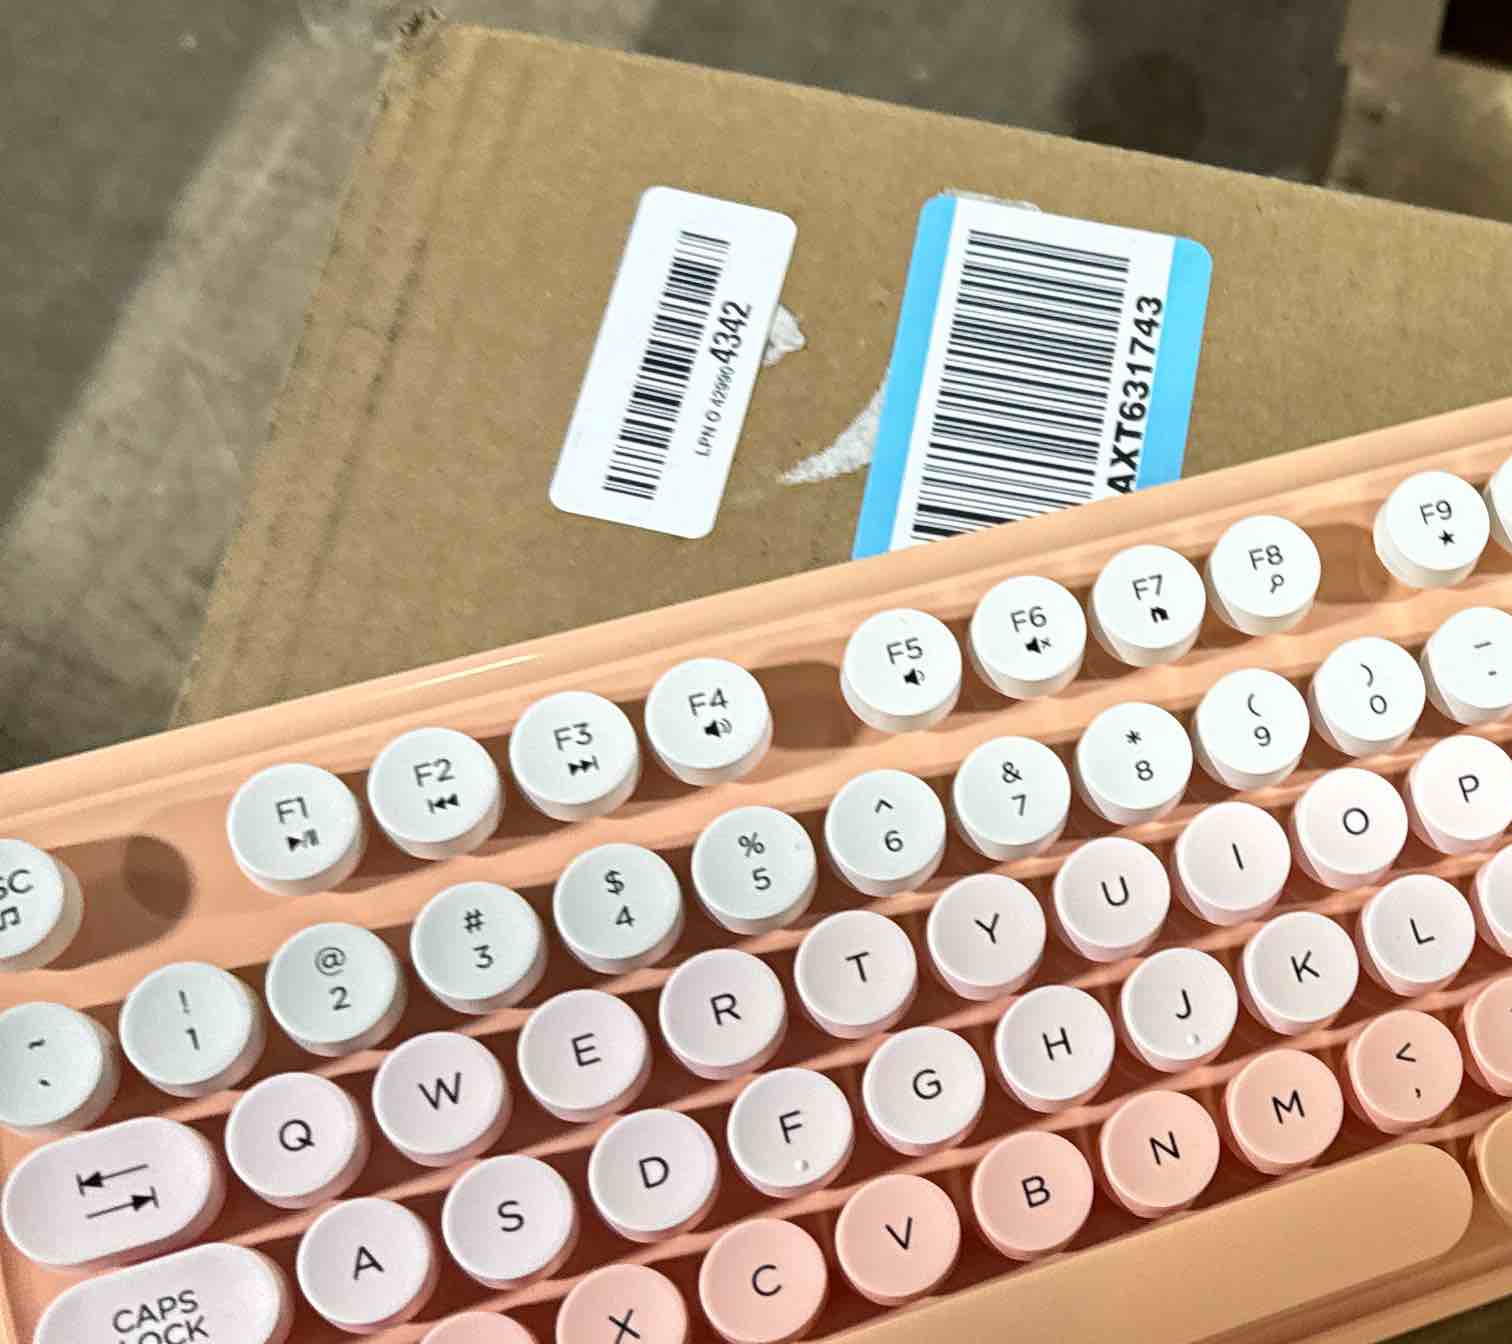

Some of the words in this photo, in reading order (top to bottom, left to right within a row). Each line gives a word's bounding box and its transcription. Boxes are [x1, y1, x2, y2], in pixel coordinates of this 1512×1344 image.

[709, 301, 752, 364] 4342
[1107, 296, 1162, 494] AXT631743
[1419, 500, 1453, 525] F9
[1248, 544, 1284, 571] F8
[1132, 573, 1163, 601] F7
[1010, 606, 1047, 633] F6
[886, 637, 924, 665] F5
[1360, 663, 1374, 687] )
[688, 687, 729, 715] F4
[1247, 693, 1262, 717] (
[1369, 694, 1388, 715] 0
[553, 722, 593, 751] F3
[1253, 725, 1272, 747] 9
[413, 758, 454, 787] F2
[1002, 761, 1023, 784] &
[1135, 759, 1154, 782] 8
[1458, 774, 1480, 803] P
[275, 796, 309, 825] F1
[874, 799, 894, 813] ^
[1011, 793, 1027, 817] 7
[1342, 807, 1370, 836] O
[737, 831, 766, 858] %
[884, 830, 904, 853] 6
[1231, 843, 1244, 870] I
[604, 870, 625, 895] $
[752, 867, 772, 891] 5
[1101, 875, 1130, 907] U
[463, 909, 484, 934] #
[615, 905, 635, 927] 4
[974, 913, 1000, 945] Y
[1409, 918, 1435, 945] L
[314, 946, 346, 977] @
[473, 944, 494, 969] 3
[845, 951, 869, 983] T
[1290, 950, 1321, 983] K
[178, 989, 190, 1014] !
[329, 986, 351, 1011] 2
[710, 993, 742, 1026] R
[1175, 989, 1192, 1020] J
[185, 1027, 200, 1050] 1
[571, 1032, 601, 1067] E
[1042, 1027, 1073, 1061] H
[1395, 1042, 1417, 1063] <
[417, 1071, 462, 1110] W
[912, 1068, 943, 1100] G
[1271, 1089, 1305, 1125] M
[278, 1119, 315, 1152] Q
[778, 1110, 803, 1144] F
[1149, 1131, 1181, 1166] N
[638, 1156, 670, 1190] D
[1021, 1175, 1051, 1209] B
[497, 1200, 525, 1233] S
[885, 1216, 913, 1251] V
[353, 1245, 384, 1281] A
[751, 1263, 782, 1297] C
[112, 1289, 200, 1335] CAPS
